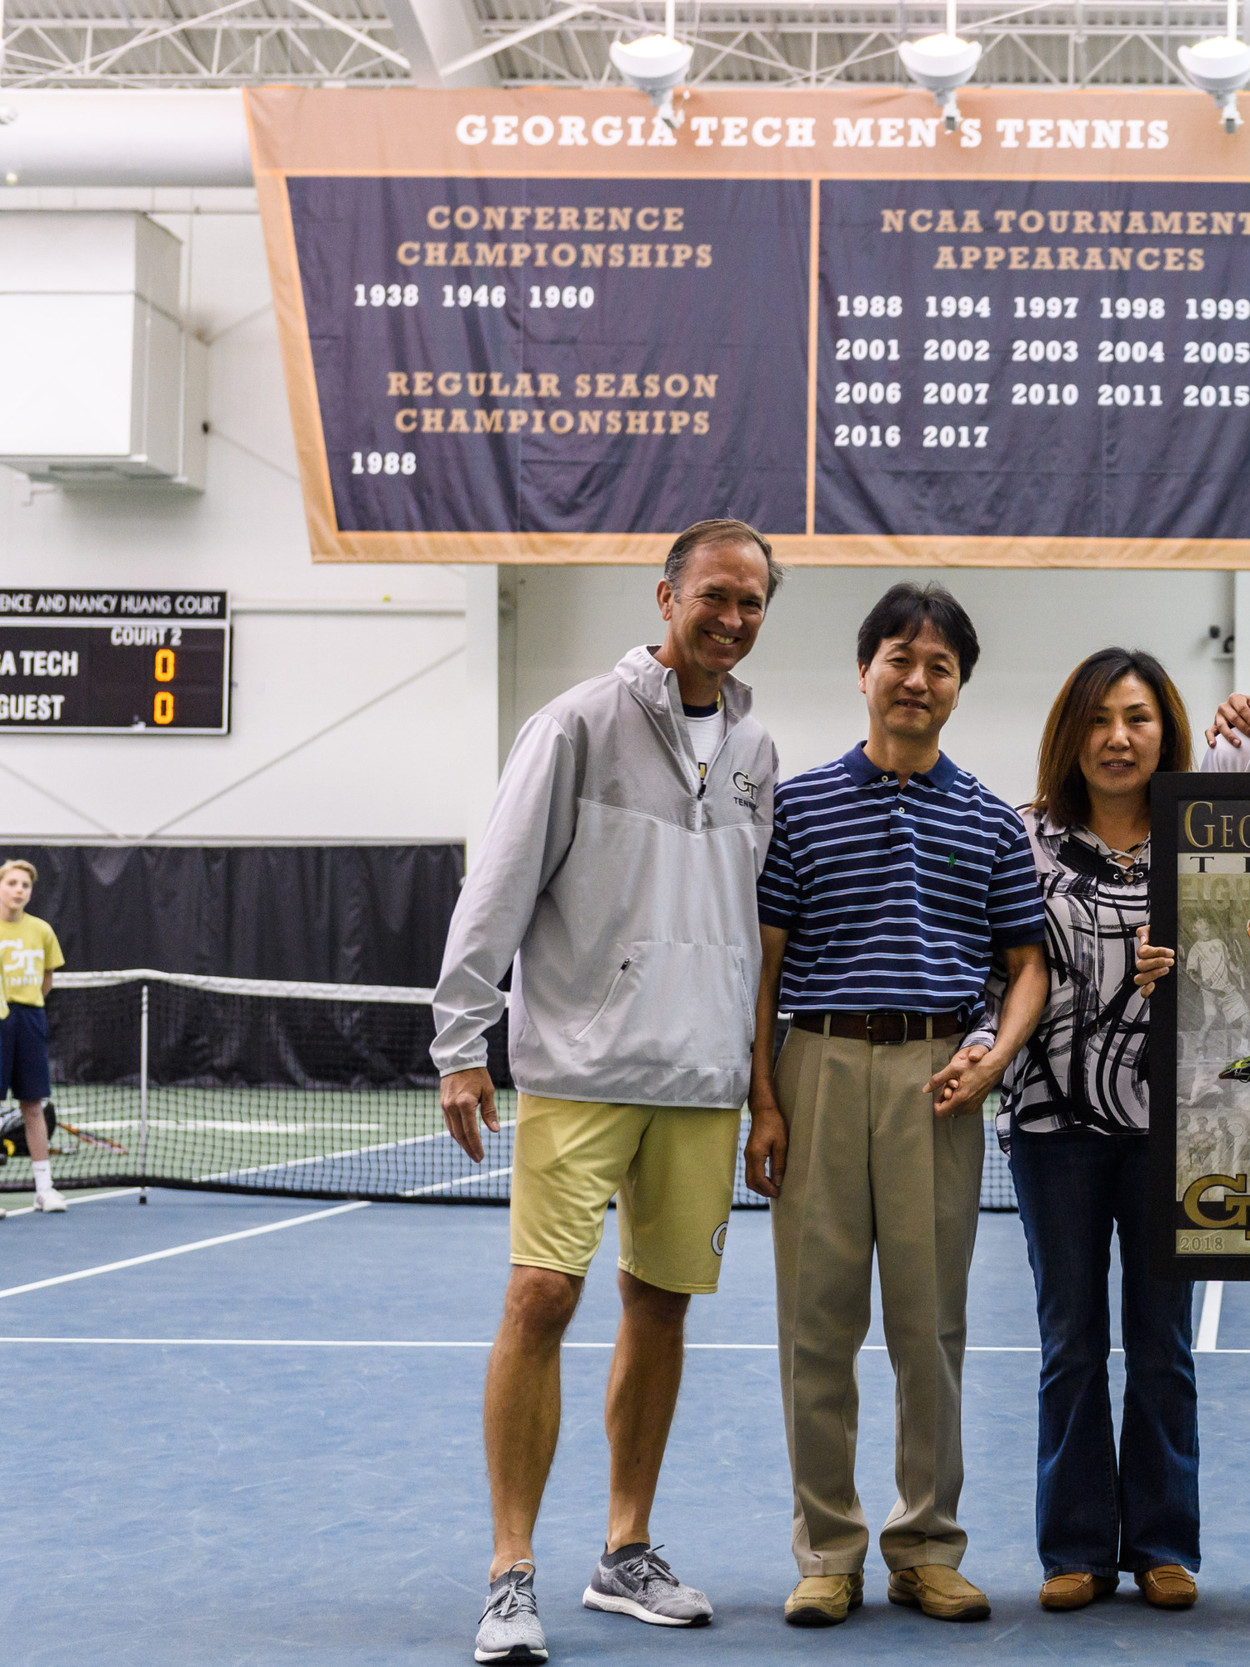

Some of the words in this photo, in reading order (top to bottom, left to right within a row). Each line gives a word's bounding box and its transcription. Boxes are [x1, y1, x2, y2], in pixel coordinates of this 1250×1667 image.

[455, 115, 678, 146] GEORGIA
[691, 116, 816, 147] TECH
[832, 117, 982, 147] MENS
[997, 119, 1170, 150] TENNIS
[427, 206, 683, 231] CONFERENCE
[882, 209, 983, 232] NCAA
[397, 241, 712, 267] CHAMPIONSHIPS
[934, 246, 1204, 271] APPEARANCES
[355, 284, 419, 307] 1938
[442, 285, 506, 308] 1946
[529, 286, 594, 308] 1960
[838, 295, 902, 317] 1988
[926, 296, 991, 318] 1994
[1014, 297, 1079, 318] 1997
[1100, 298, 1165, 319] 1998
[1186, 298, 1250, 320] 1999
[836, 339, 900, 361] 2001
[924, 339, 989, 361] 2002
[1012, 340, 1078, 362] 2003
[1098, 341, 1164, 362] 2004
[1184, 342, 1250, 363] 2005
[387, 372, 561, 397] REGULAR
[575, 374, 718, 398] SEASON
[835, 382, 901, 404] 2006
[923, 383, 989, 404] 2007
[1012, 383, 1078, 405] 2010
[1098, 384, 1162, 406] 2011
[1184, 385, 1250, 407] 2015
[395, 409, 709, 434] CHAMPIONSHIPS
[835, 425, 900, 447] 2016
[923, 426, 988, 447] 2017
[352, 452, 416, 475] 1988
[36, 593, 67, 613] AND
[69, 594, 118, 614] NANCY
[121, 596, 171, 614] HUANG
[175, 597, 221, 615] COURT
[110, 625, 166, 646] COURT
[170, 627, 182, 646] 2
[19, 650, 79, 677] TECH
[155, 649, 174, 681] 0
[0, 694, 65, 721] GUEST
[154, 692, 173, 724] 0
[732, 771, 759, 800] GT
[0, 939, 45, 976] GT
[1180, 1236, 1224, 1252] 2018
